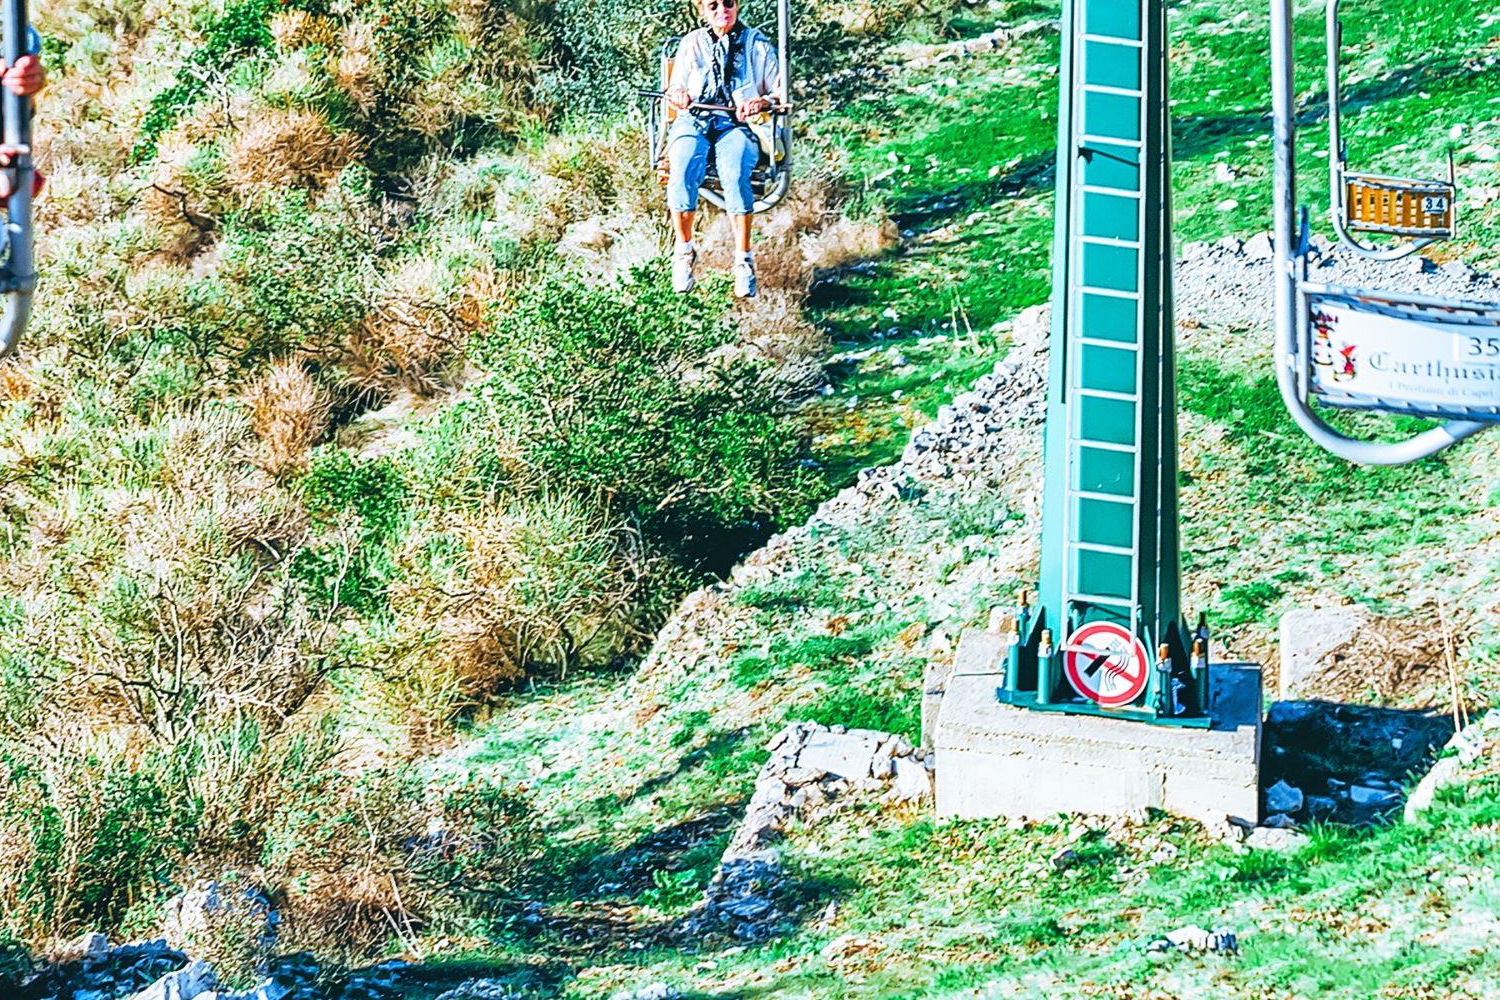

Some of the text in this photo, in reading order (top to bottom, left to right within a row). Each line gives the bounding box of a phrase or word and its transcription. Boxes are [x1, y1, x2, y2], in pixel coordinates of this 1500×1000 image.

[1425, 197, 1444, 210] 34
[1468, 336, 1500, 357] 35
[1369, 351, 1500, 384] Carthusi
